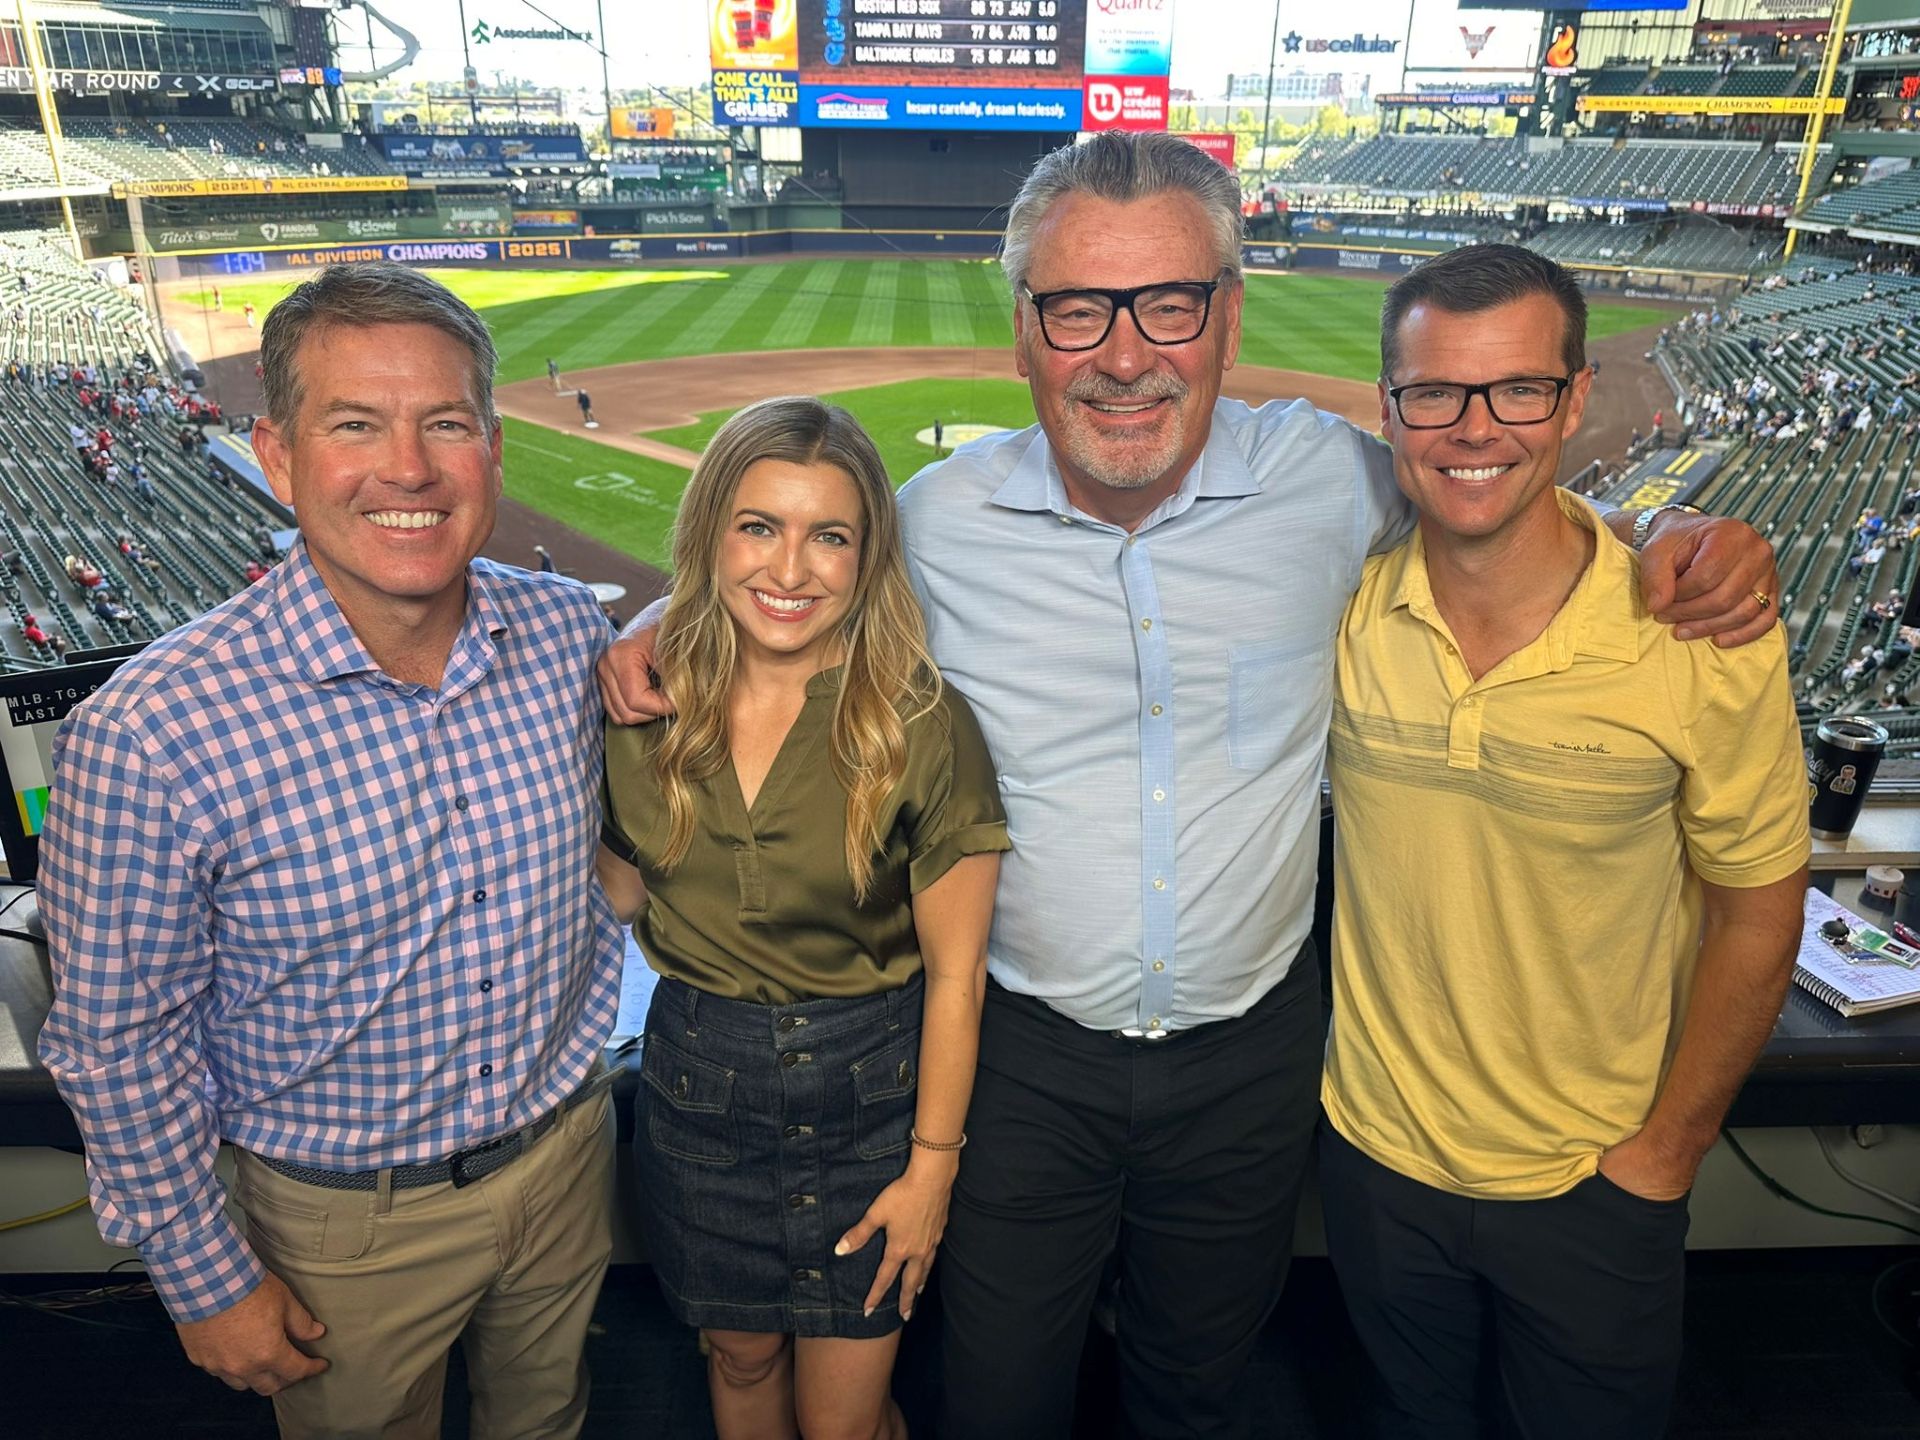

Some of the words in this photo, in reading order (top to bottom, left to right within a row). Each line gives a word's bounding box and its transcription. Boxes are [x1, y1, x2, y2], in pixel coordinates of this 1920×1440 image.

[855, 0, 895, 13] BOSTON
[897, 0, 917, 14] RED
[919, 0, 940, 14] SOX
[494, 26, 565, 40] Associated
[855, 22, 891, 38] TAMPA
[892, 23, 913, 38] BAY
[915, 23, 942, 39] RAYS
[971, 24, 985, 40] 77
[856, 46, 912, 62] BALTIMORE
[913, 47, 954, 63] ORIOLES
[25, 71, 74, 88] YAR
[87, 72, 161, 89] ROUND
[225, 78, 274, 90] GOLF
[714, 71, 747, 87] ONE
[714, 87, 764, 102] THAT'S
[1124, 87, 1145, 97] uw
[1123, 96, 1162, 108] credit
[1706, 99, 1773, 109] CHAMPIONS
[724, 101, 788, 118] GRUBER
[906, 100, 937, 115] Insure
[985, 101, 1015, 116] dream
[1016, 101, 1066, 119] fearlessly.
[1123, 107, 1162, 119] union
[132, 182, 195, 194] CHAMPIONS
[211, 182, 249, 191] 2025
[298, 181, 340, 189] CENTRAL
[345, 180, 387, 188] DIVISION
[680, 212, 705, 224] Save
[160, 231, 194, 244] Tito's
[508, 242, 561, 257] 2025
[706, 242, 728, 251] Farm
[288, 253, 311, 265] AL
[314, 249, 383, 264] DIVISION
[388, 243, 488, 261] CHAMPIONS
[224, 253, 266, 273] 1:04
[14, 706, 57, 723] LAST
